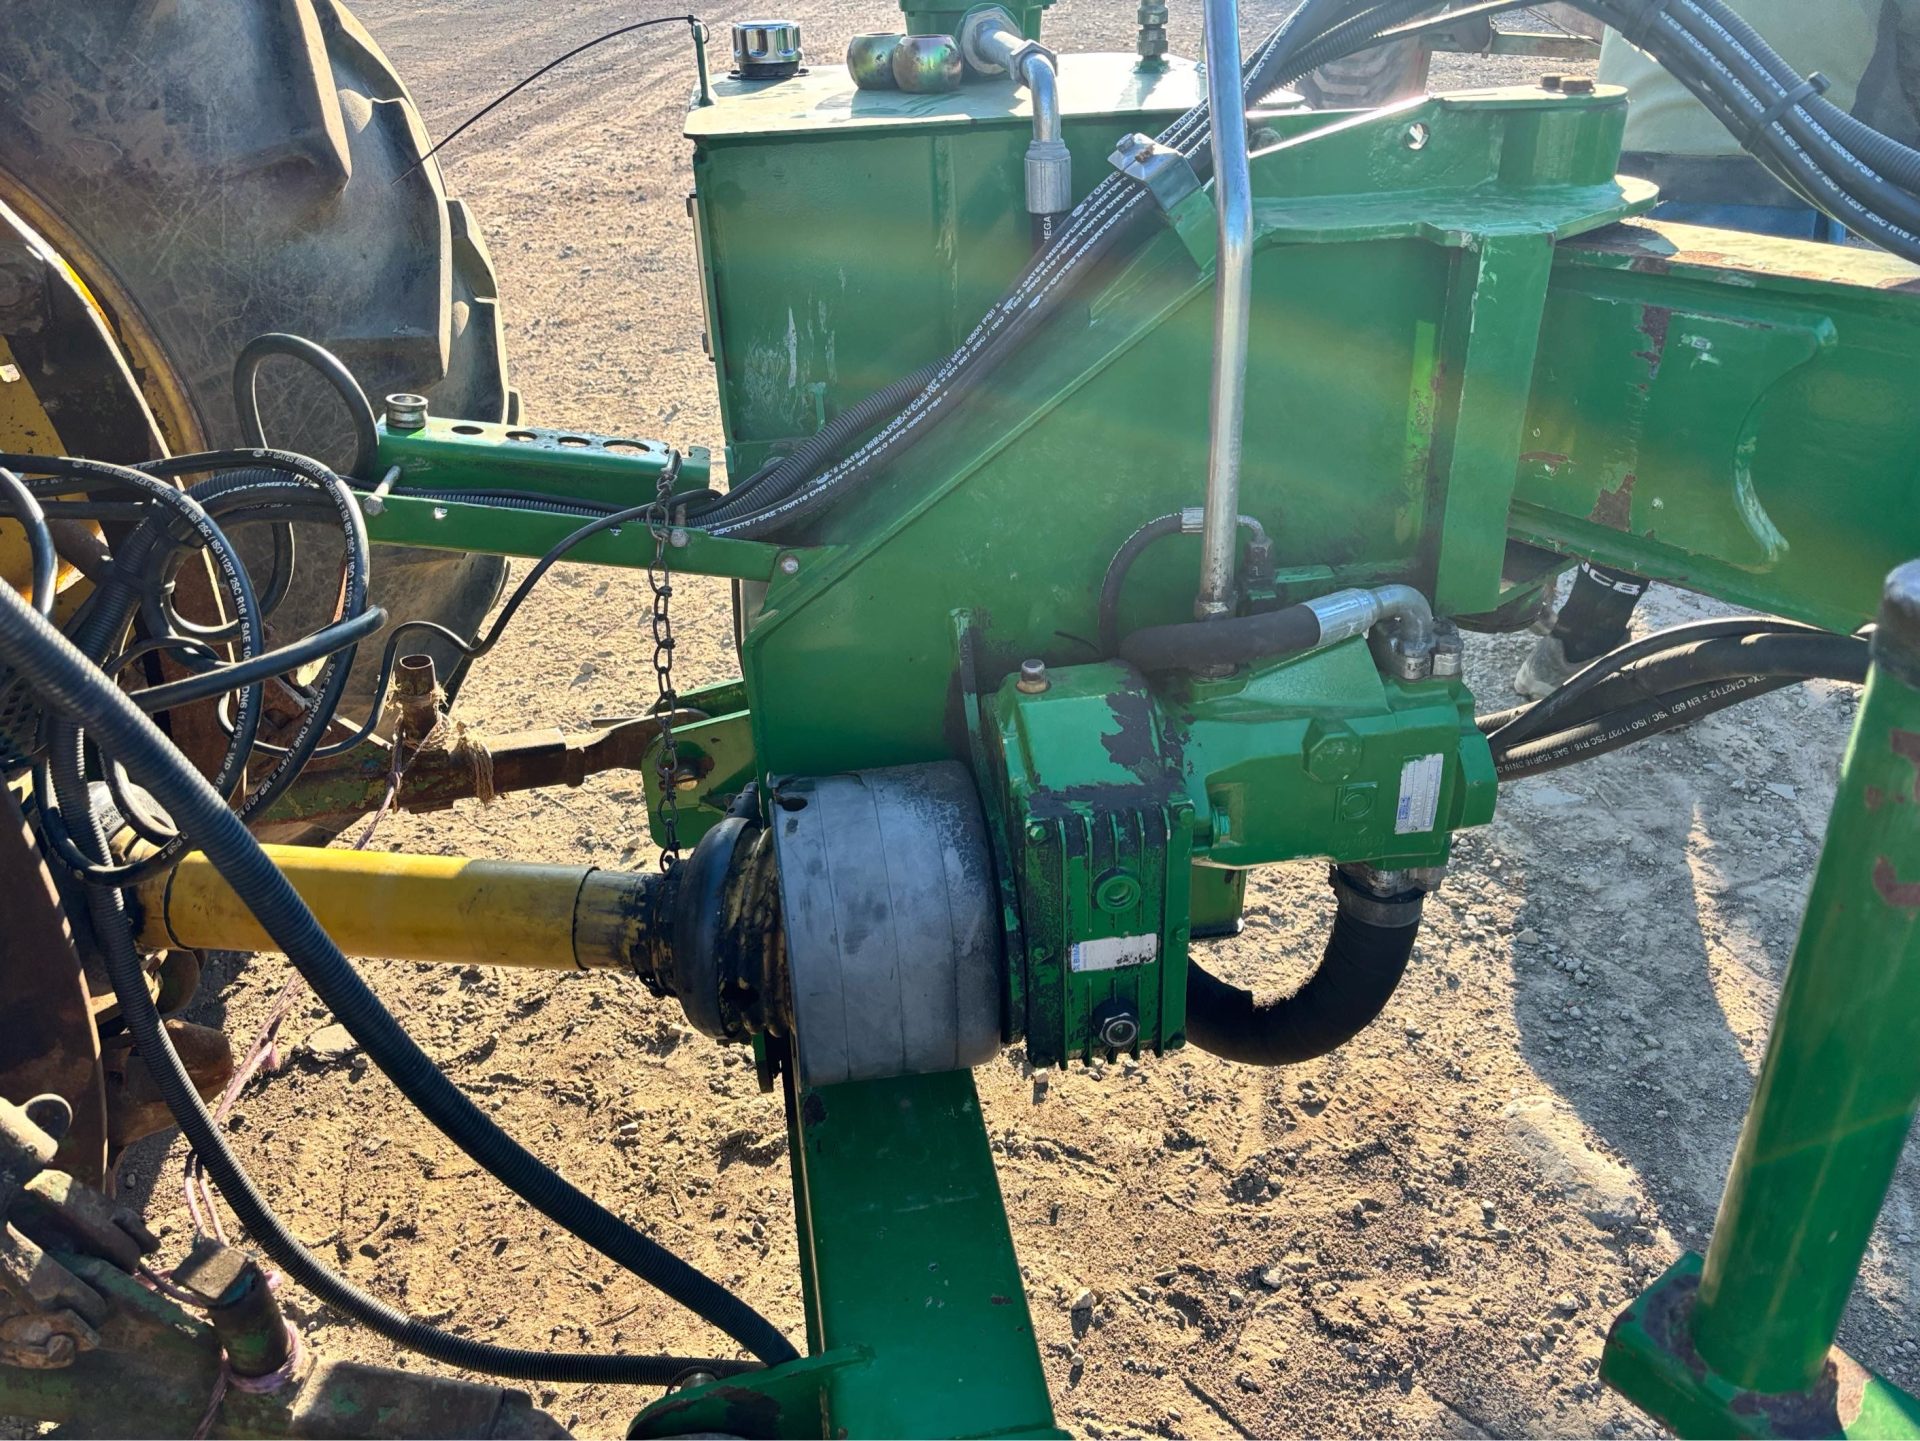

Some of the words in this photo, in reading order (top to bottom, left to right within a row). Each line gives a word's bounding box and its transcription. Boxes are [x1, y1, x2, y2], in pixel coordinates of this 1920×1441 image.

[1094, 171, 1120, 195] GATES
[1022, 261, 1045, 288] GATES
[1045, 217, 1086, 261] MEGAFLEX
[1050, 259, 1076, 286] GATES
[1076, 212, 1121, 258] MEGAFLEX
[937, 363, 951, 379] 40.0
[273, 451, 295, 463] GATES
[198, 522, 212, 538] 2SC
[211, 539, 224, 554] ISO
[220, 554, 236, 576] 11237
[230, 578, 241, 595] 2SC
[236, 596, 247, 615] R16
[241, 622, 251, 643] SAE
[240, 685, 250, 709] DN6
[1687, 696, 1701, 708] EN
[1672, 703, 1687, 714] 857
[1632, 719, 1647, 730] ISO
[1574, 741, 1590, 751] R16
[1591, 735, 1607, 746] 2SC
[224, 752, 235, 770] WP
